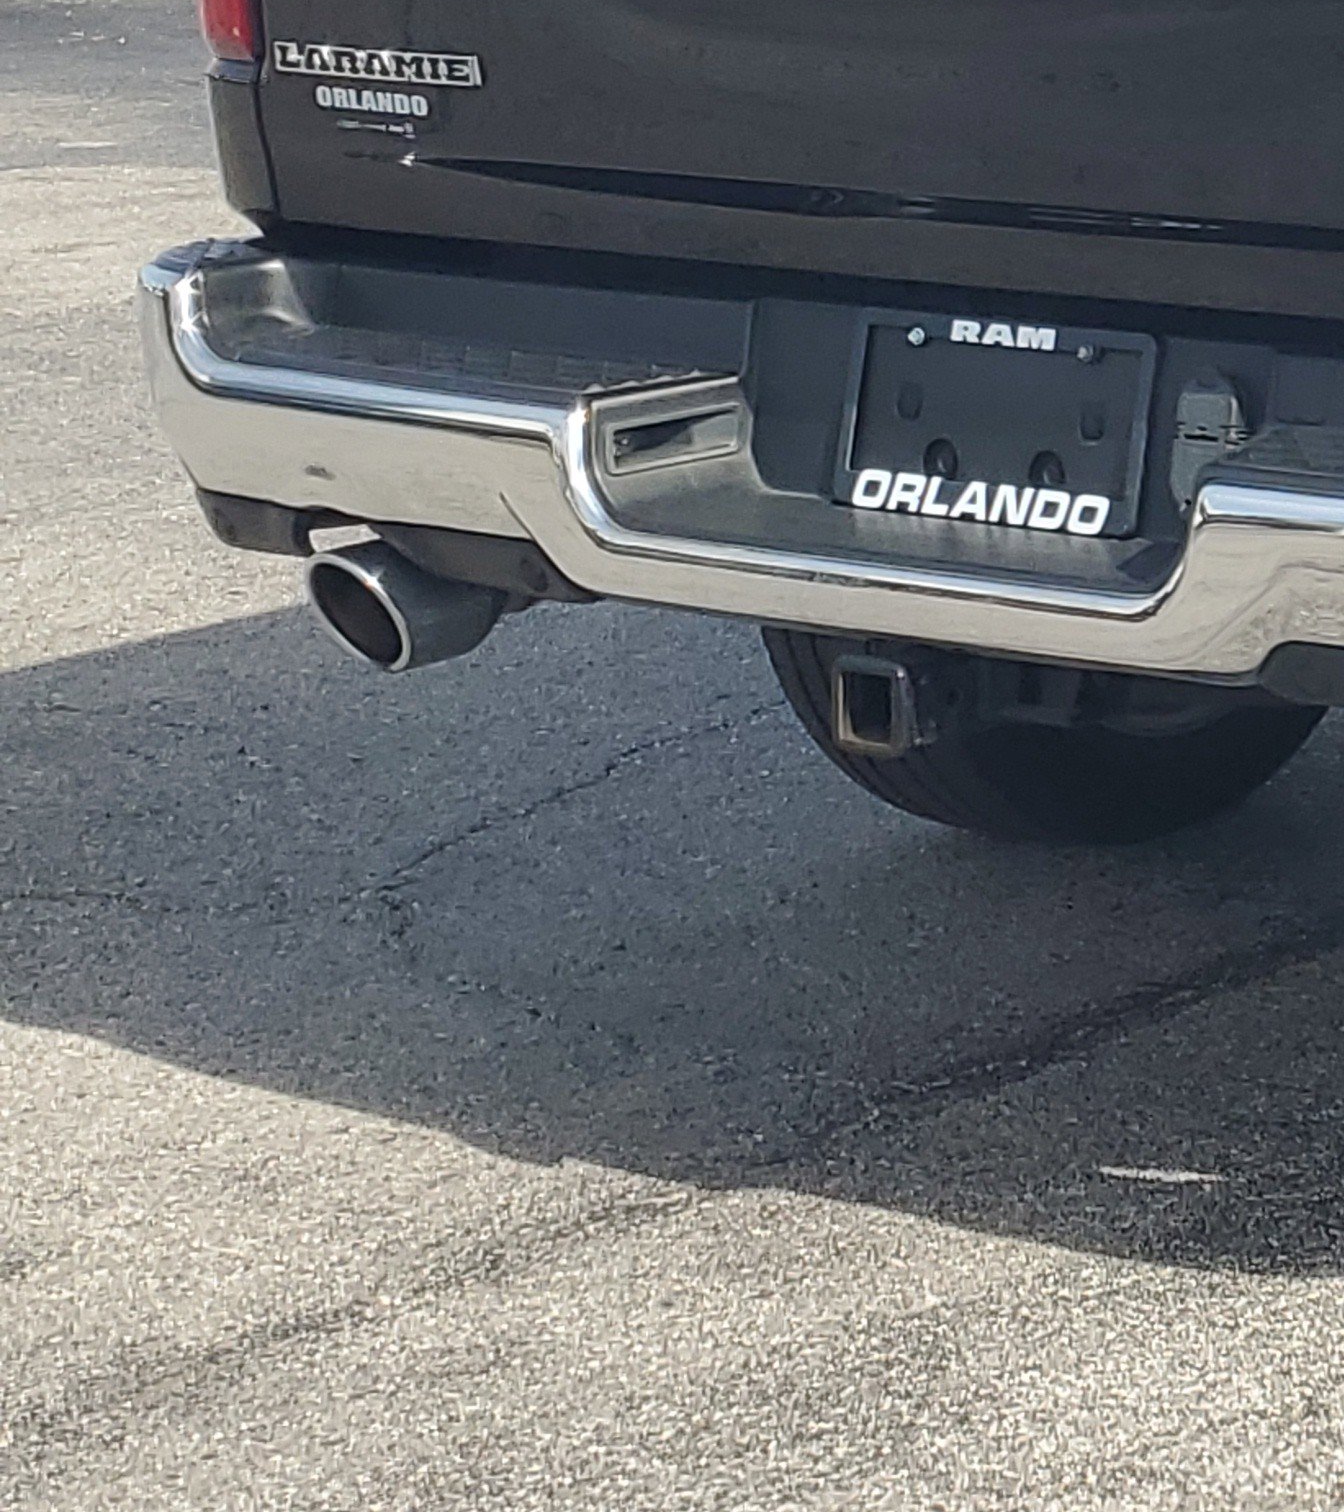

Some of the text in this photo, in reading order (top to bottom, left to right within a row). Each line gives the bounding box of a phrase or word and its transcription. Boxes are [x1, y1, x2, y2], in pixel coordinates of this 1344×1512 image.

[274, 42, 479, 86] LARAMIE
[315, 85, 429, 117] ORLANDO
[950, 319, 1056, 351] RAM
[852, 468, 1110, 535] ORLANDO
